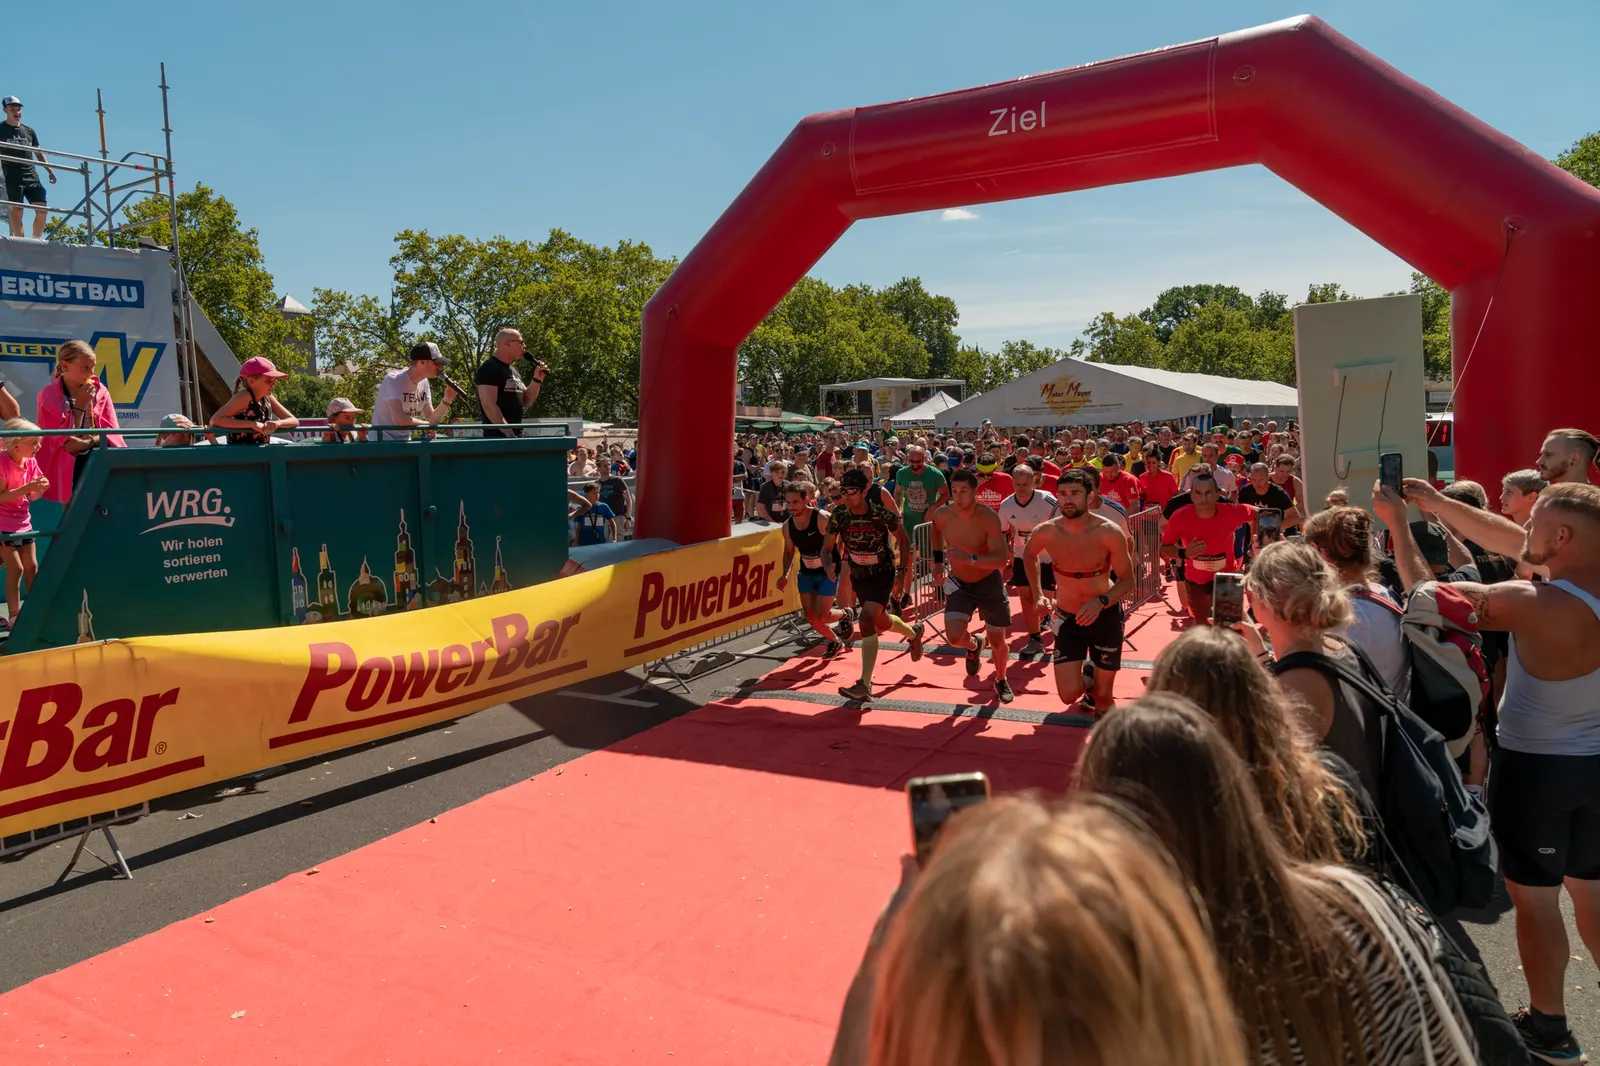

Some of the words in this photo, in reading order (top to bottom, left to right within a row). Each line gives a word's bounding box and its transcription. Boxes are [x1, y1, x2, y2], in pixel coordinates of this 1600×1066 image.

[988, 101, 1046, 136] Ziel
[1, 275, 139, 302] ERÜSTBAU
[1065, 381, 1092, 398] Mayer
[161, 540, 184, 552] Wir
[188, 537, 223, 549] holen
[163, 553, 221, 568] sortieren
[164, 568, 228, 584] verwerten
[634, 554, 776, 640] PowerBar
[287, 612, 582, 725] PowerBar
